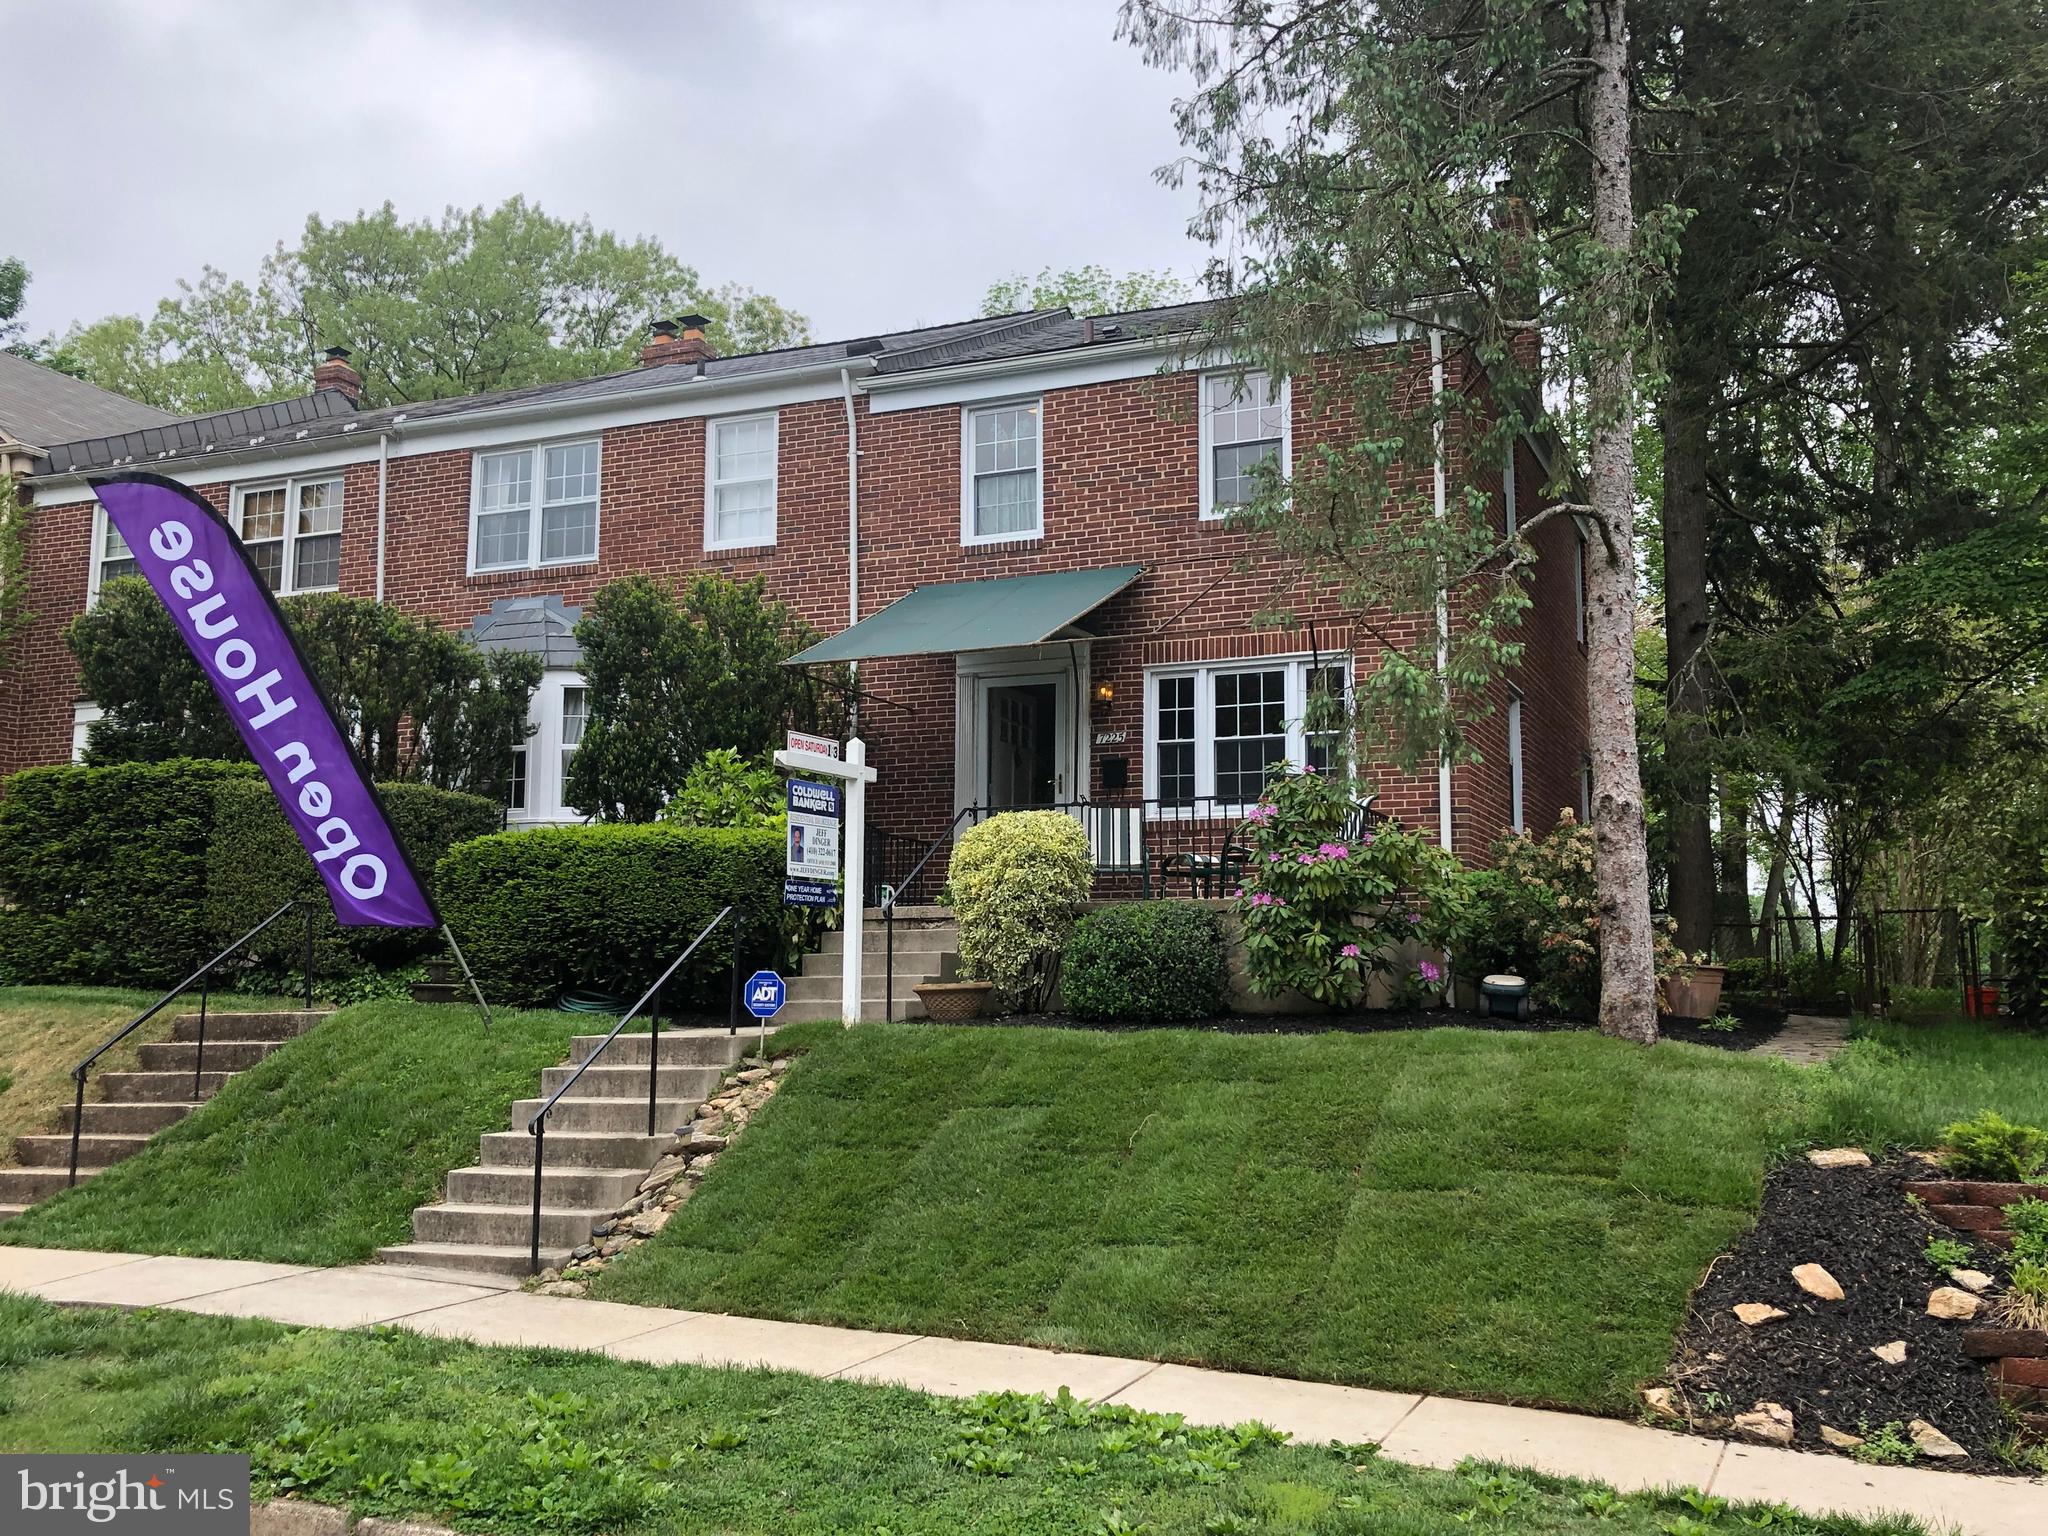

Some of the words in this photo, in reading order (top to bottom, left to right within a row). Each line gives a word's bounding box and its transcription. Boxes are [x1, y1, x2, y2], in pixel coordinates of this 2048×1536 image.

[1100, 733, 1123, 742] 7225
[791, 738, 804, 750] OPEN
[805, 741, 828, 754] SATURDA
[792, 785, 835, 801] COLDWELL
[792, 795, 827, 811] BANKER
[816, 828, 827, 837] JEFF
[812, 836, 831, 846] DINGER
[787, 884, 797, 892] ONE
[798, 885, 809, 893] YEAR
[810, 886, 822, 894] HOME
[787, 893, 814, 902] PROTECTION
[815, 895, 826, 903] PLAN
[753, 986, 777, 1000] ADT
